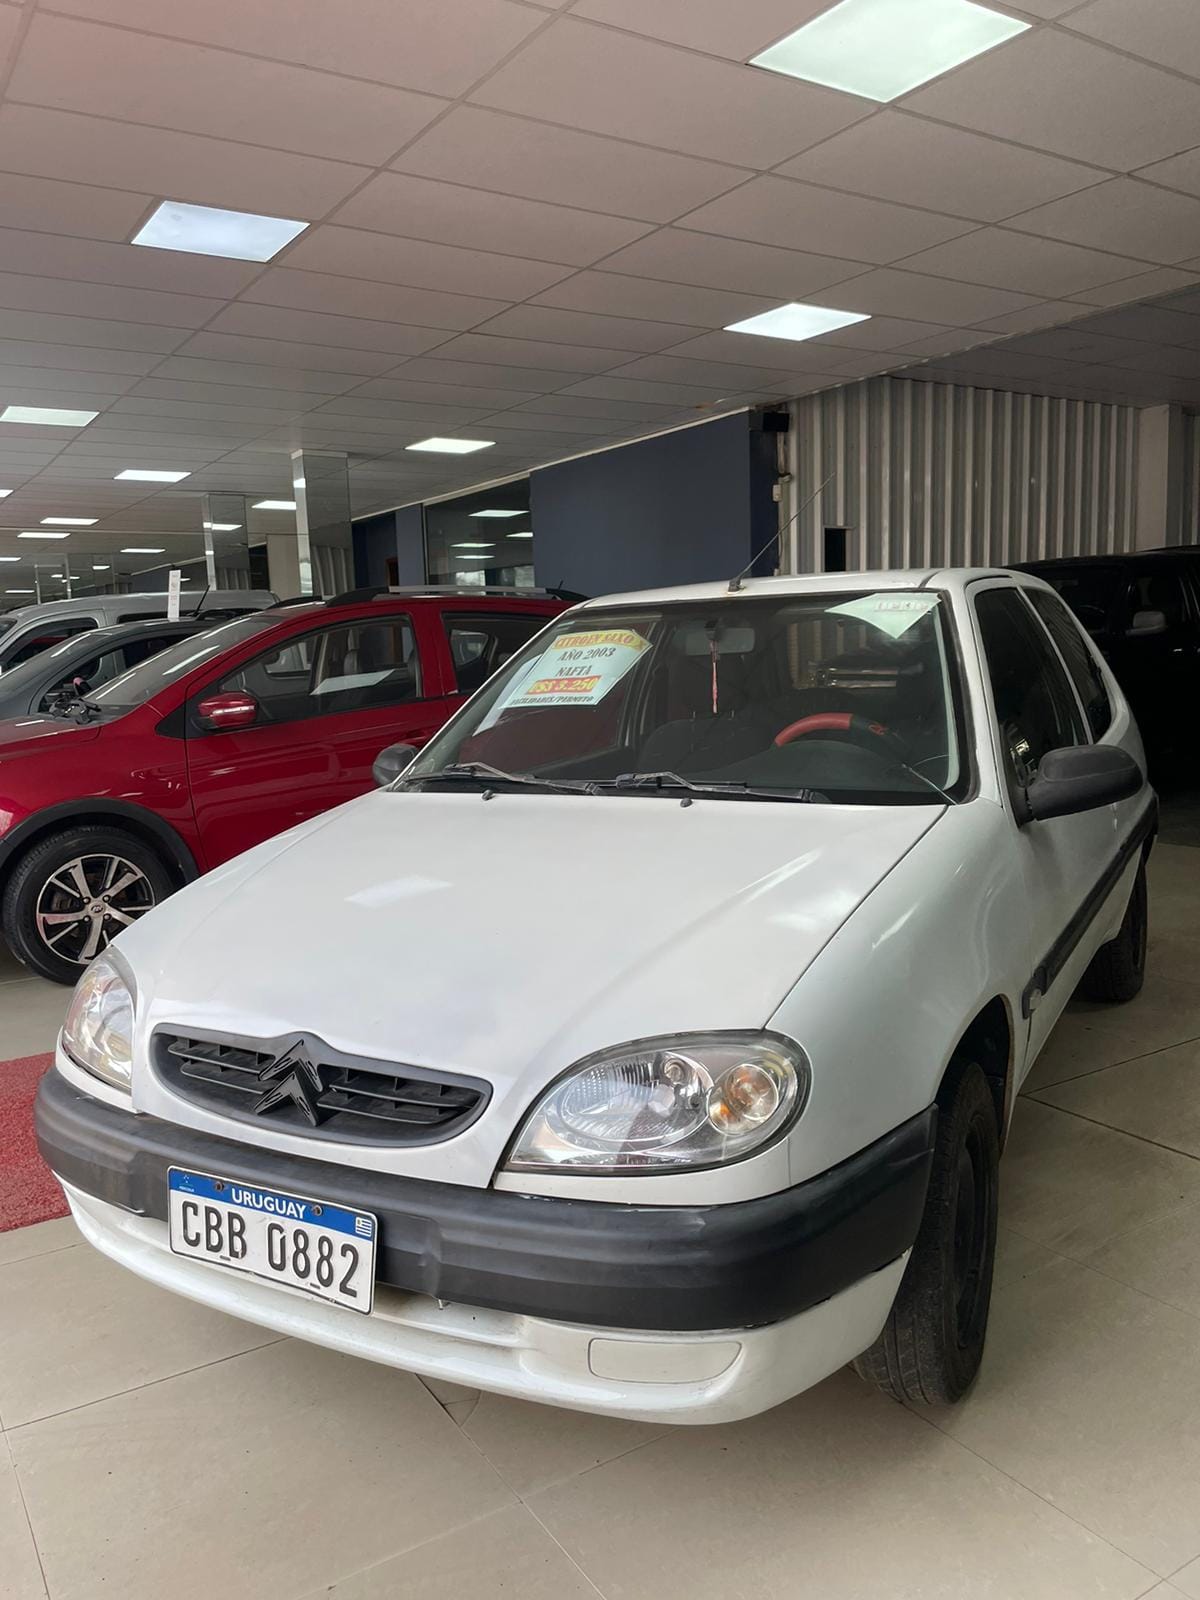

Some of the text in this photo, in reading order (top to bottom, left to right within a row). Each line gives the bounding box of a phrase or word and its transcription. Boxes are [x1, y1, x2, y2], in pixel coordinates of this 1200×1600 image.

[557, 647, 616, 661] AÑO 2003
[555, 665, 592, 677] NAFTA
[555, 678, 598, 691] 3.250
[231, 1188, 307, 1219] URUGUAY
[182, 1200, 358, 1298] CBB 0882
